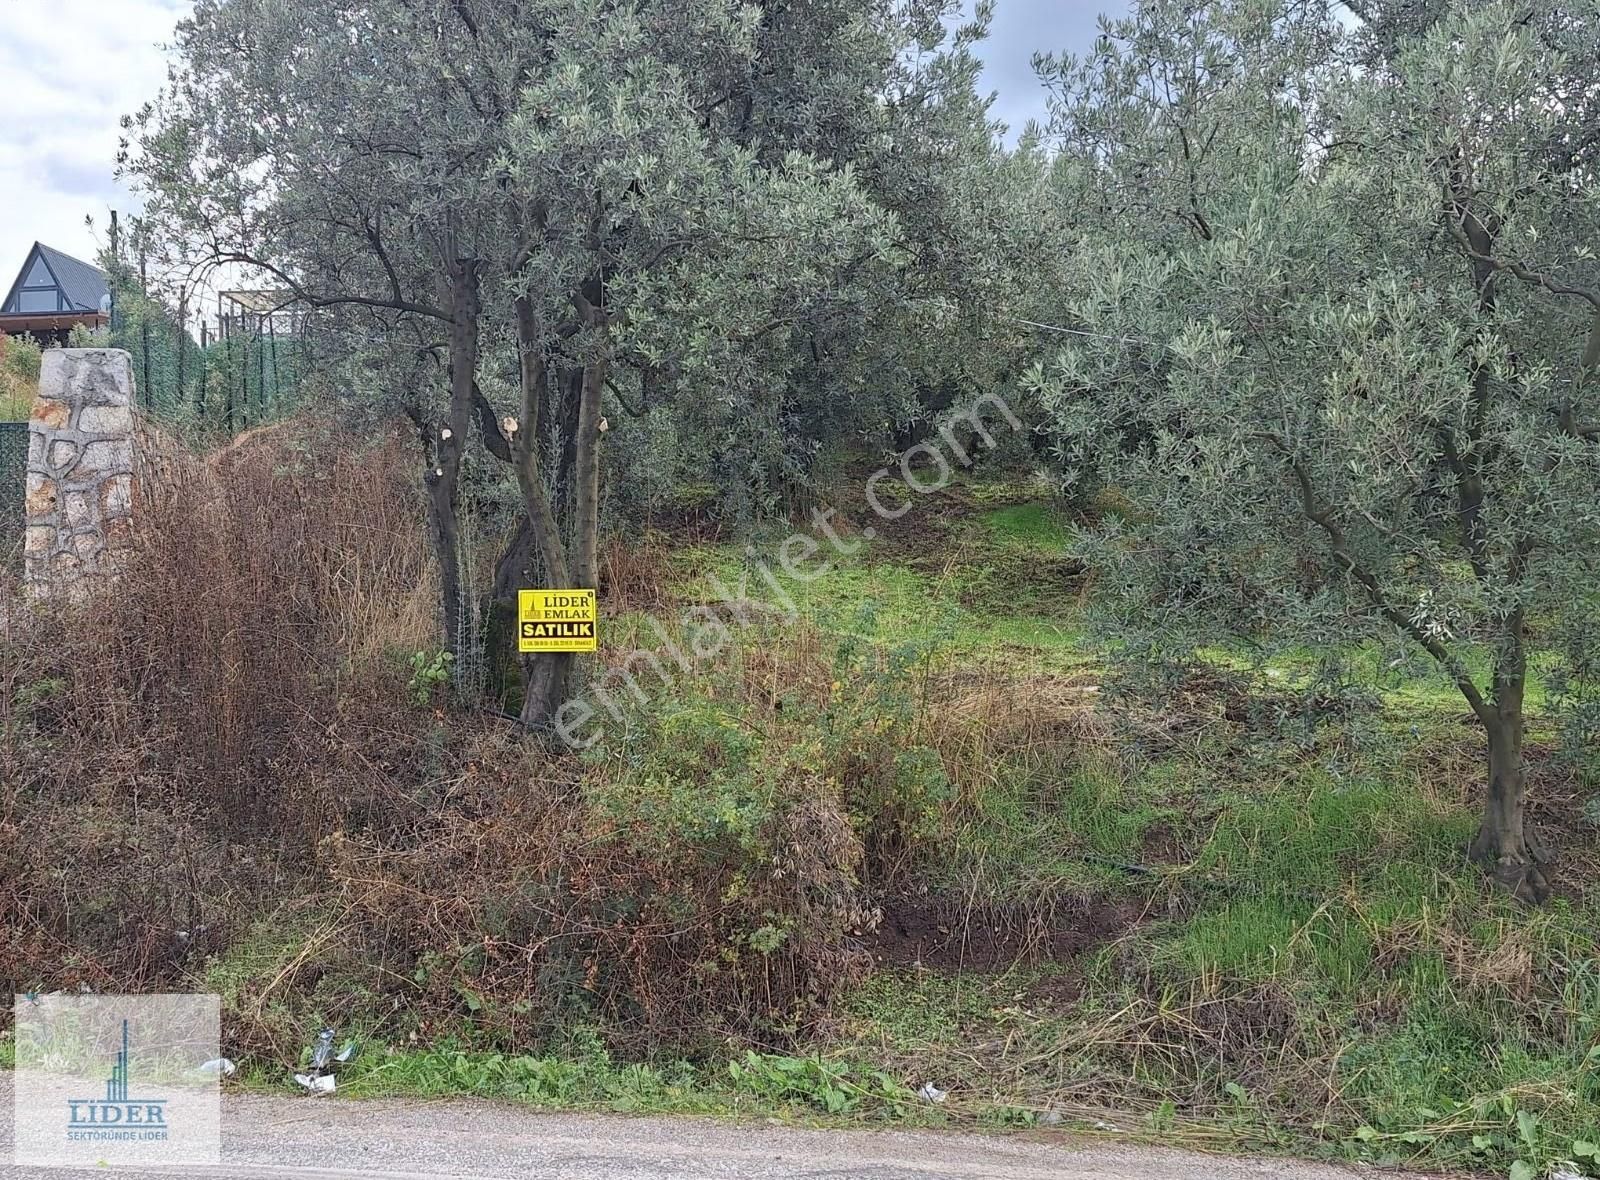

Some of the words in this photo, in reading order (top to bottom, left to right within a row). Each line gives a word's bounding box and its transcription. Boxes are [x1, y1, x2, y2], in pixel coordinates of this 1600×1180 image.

[544, 594, 590, 607] LİDER
[544, 609, 591, 619] EMLAK
[523, 623, 592, 636] SATILIK
